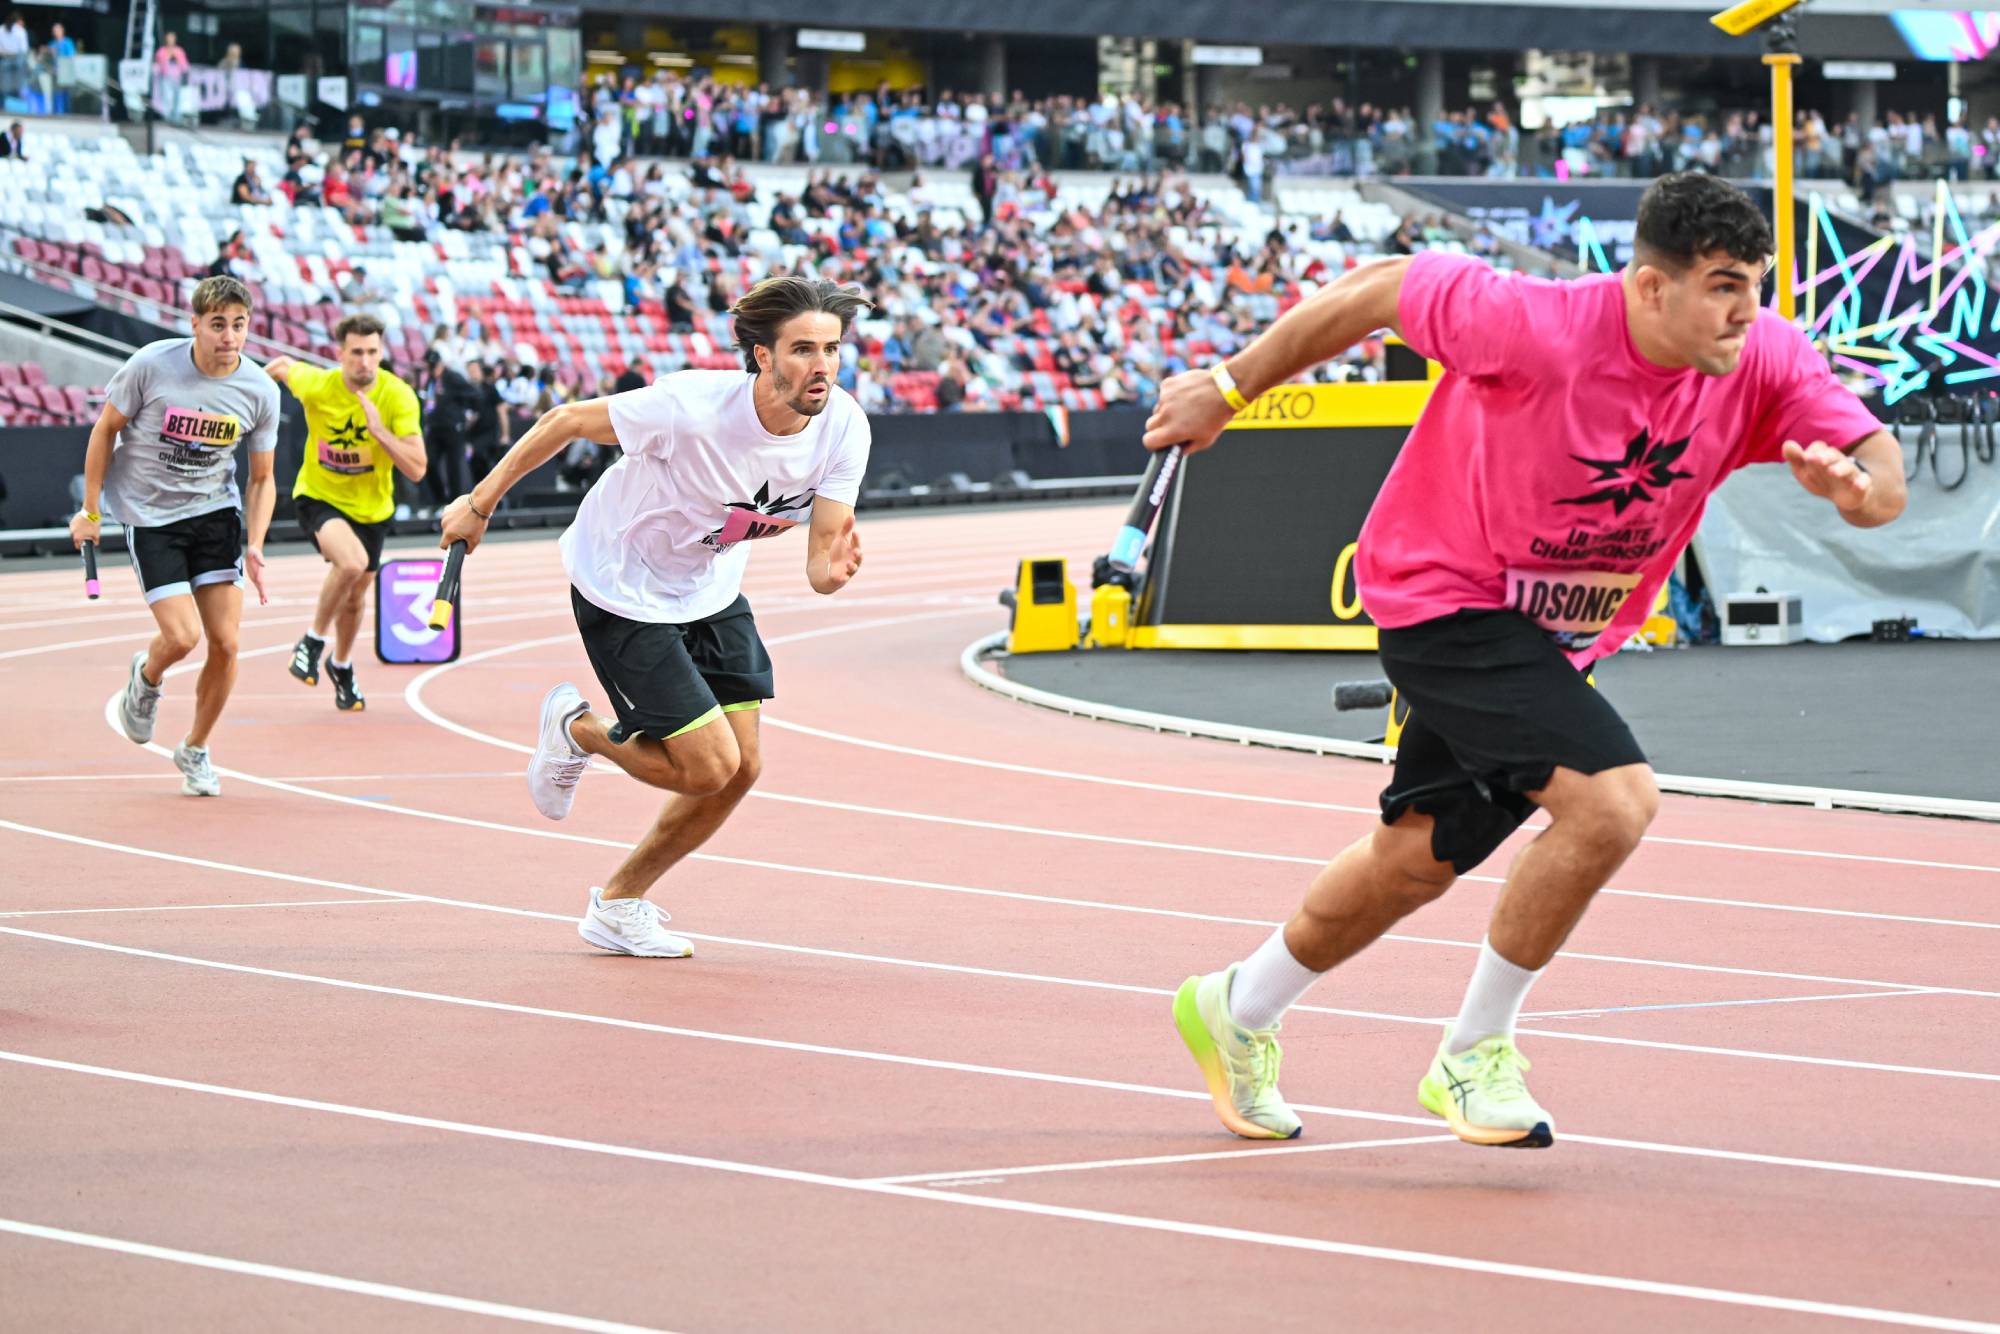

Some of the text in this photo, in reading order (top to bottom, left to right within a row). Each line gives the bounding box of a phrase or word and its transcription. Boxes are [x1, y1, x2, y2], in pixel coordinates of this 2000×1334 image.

[166, 414, 236, 441] BETLEHEM
[391, 581, 441, 646] 3
[1515, 579, 1636, 622] LOSONC
